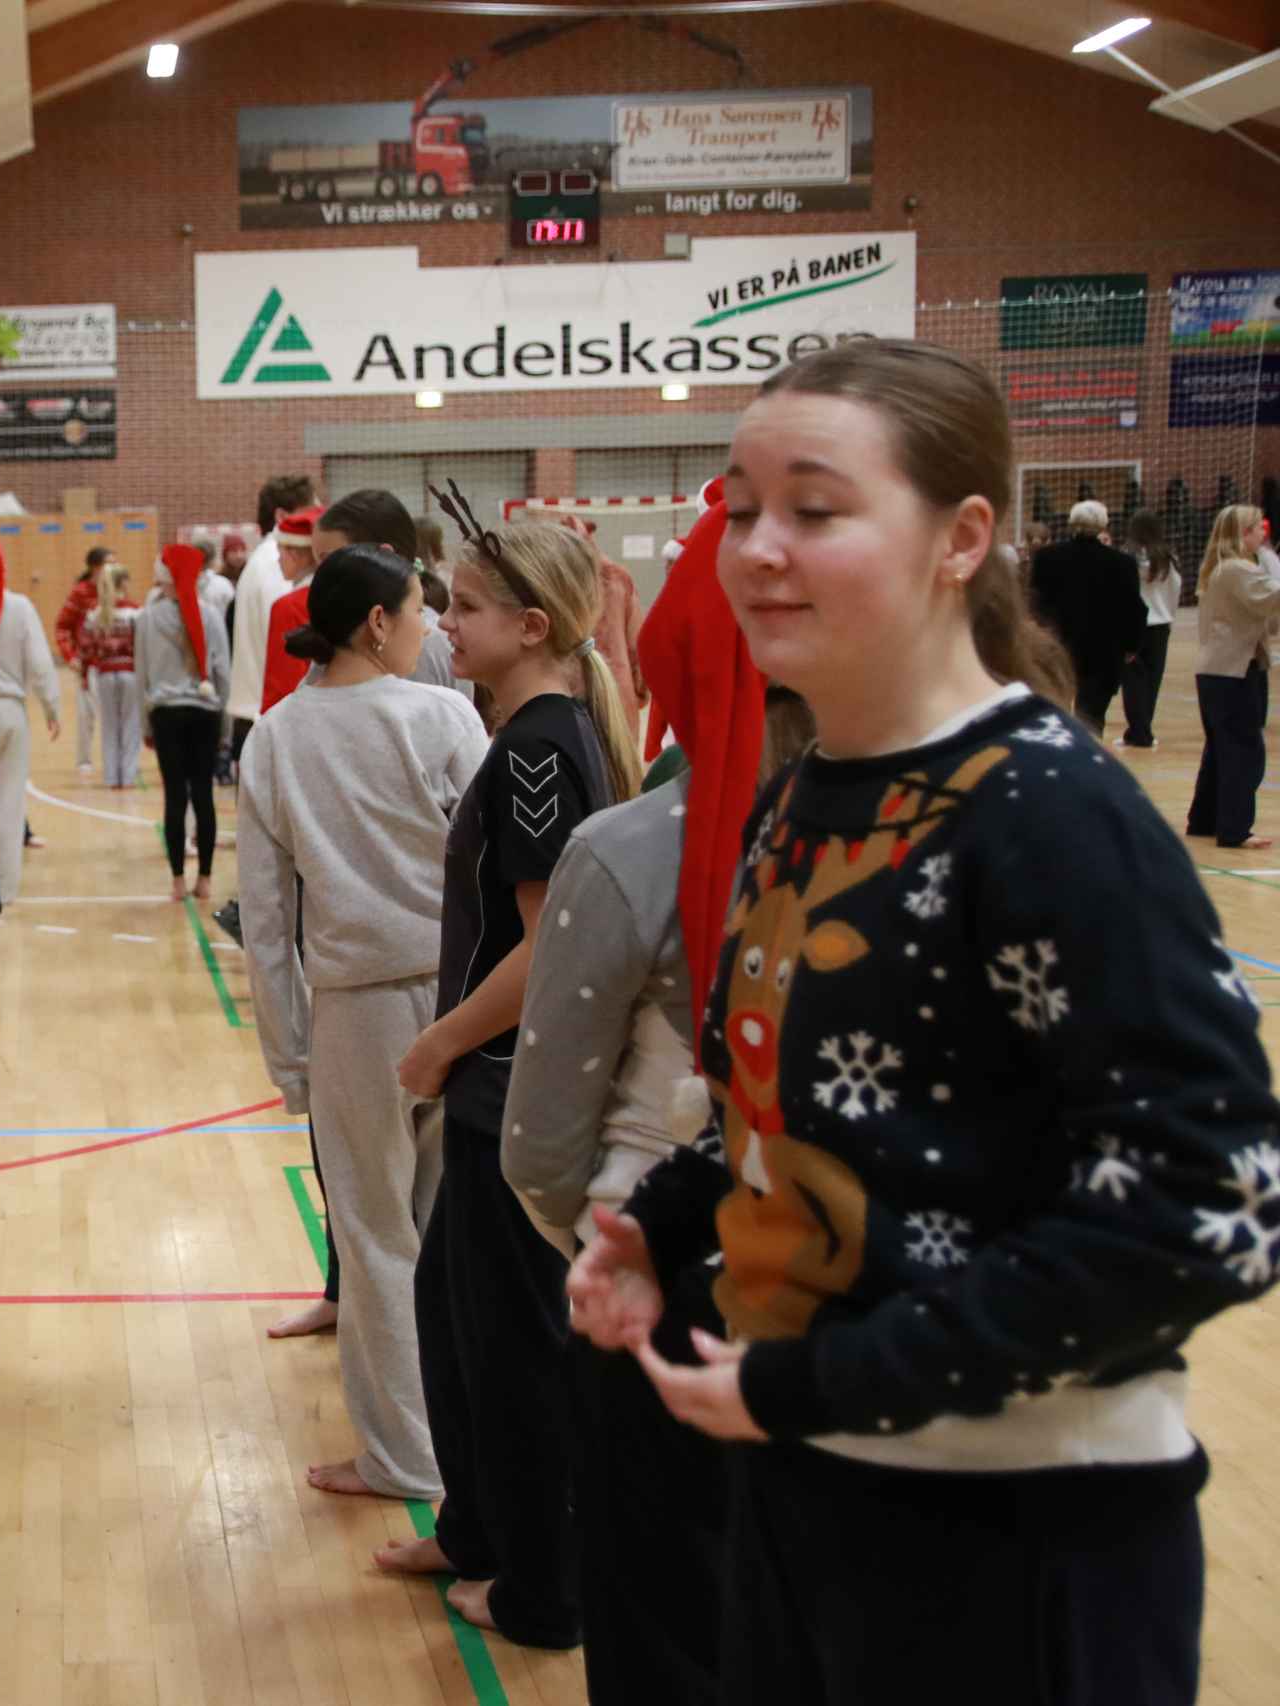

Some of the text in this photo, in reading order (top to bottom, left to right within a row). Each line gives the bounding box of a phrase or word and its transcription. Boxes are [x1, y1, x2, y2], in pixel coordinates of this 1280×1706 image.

[662, 105, 802, 127] Hans Sørensen
[688, 128, 778, 148] Transport
[320, 202, 342, 223] Vi
[348, 201, 442, 223] strækker
[452, 202, 478, 219] os
[665, 192, 719, 215] langt
[726, 190, 754, 209] for
[762, 190, 802, 212] dig.
[708, 241, 882, 310] VI ER PÅ BANEN
